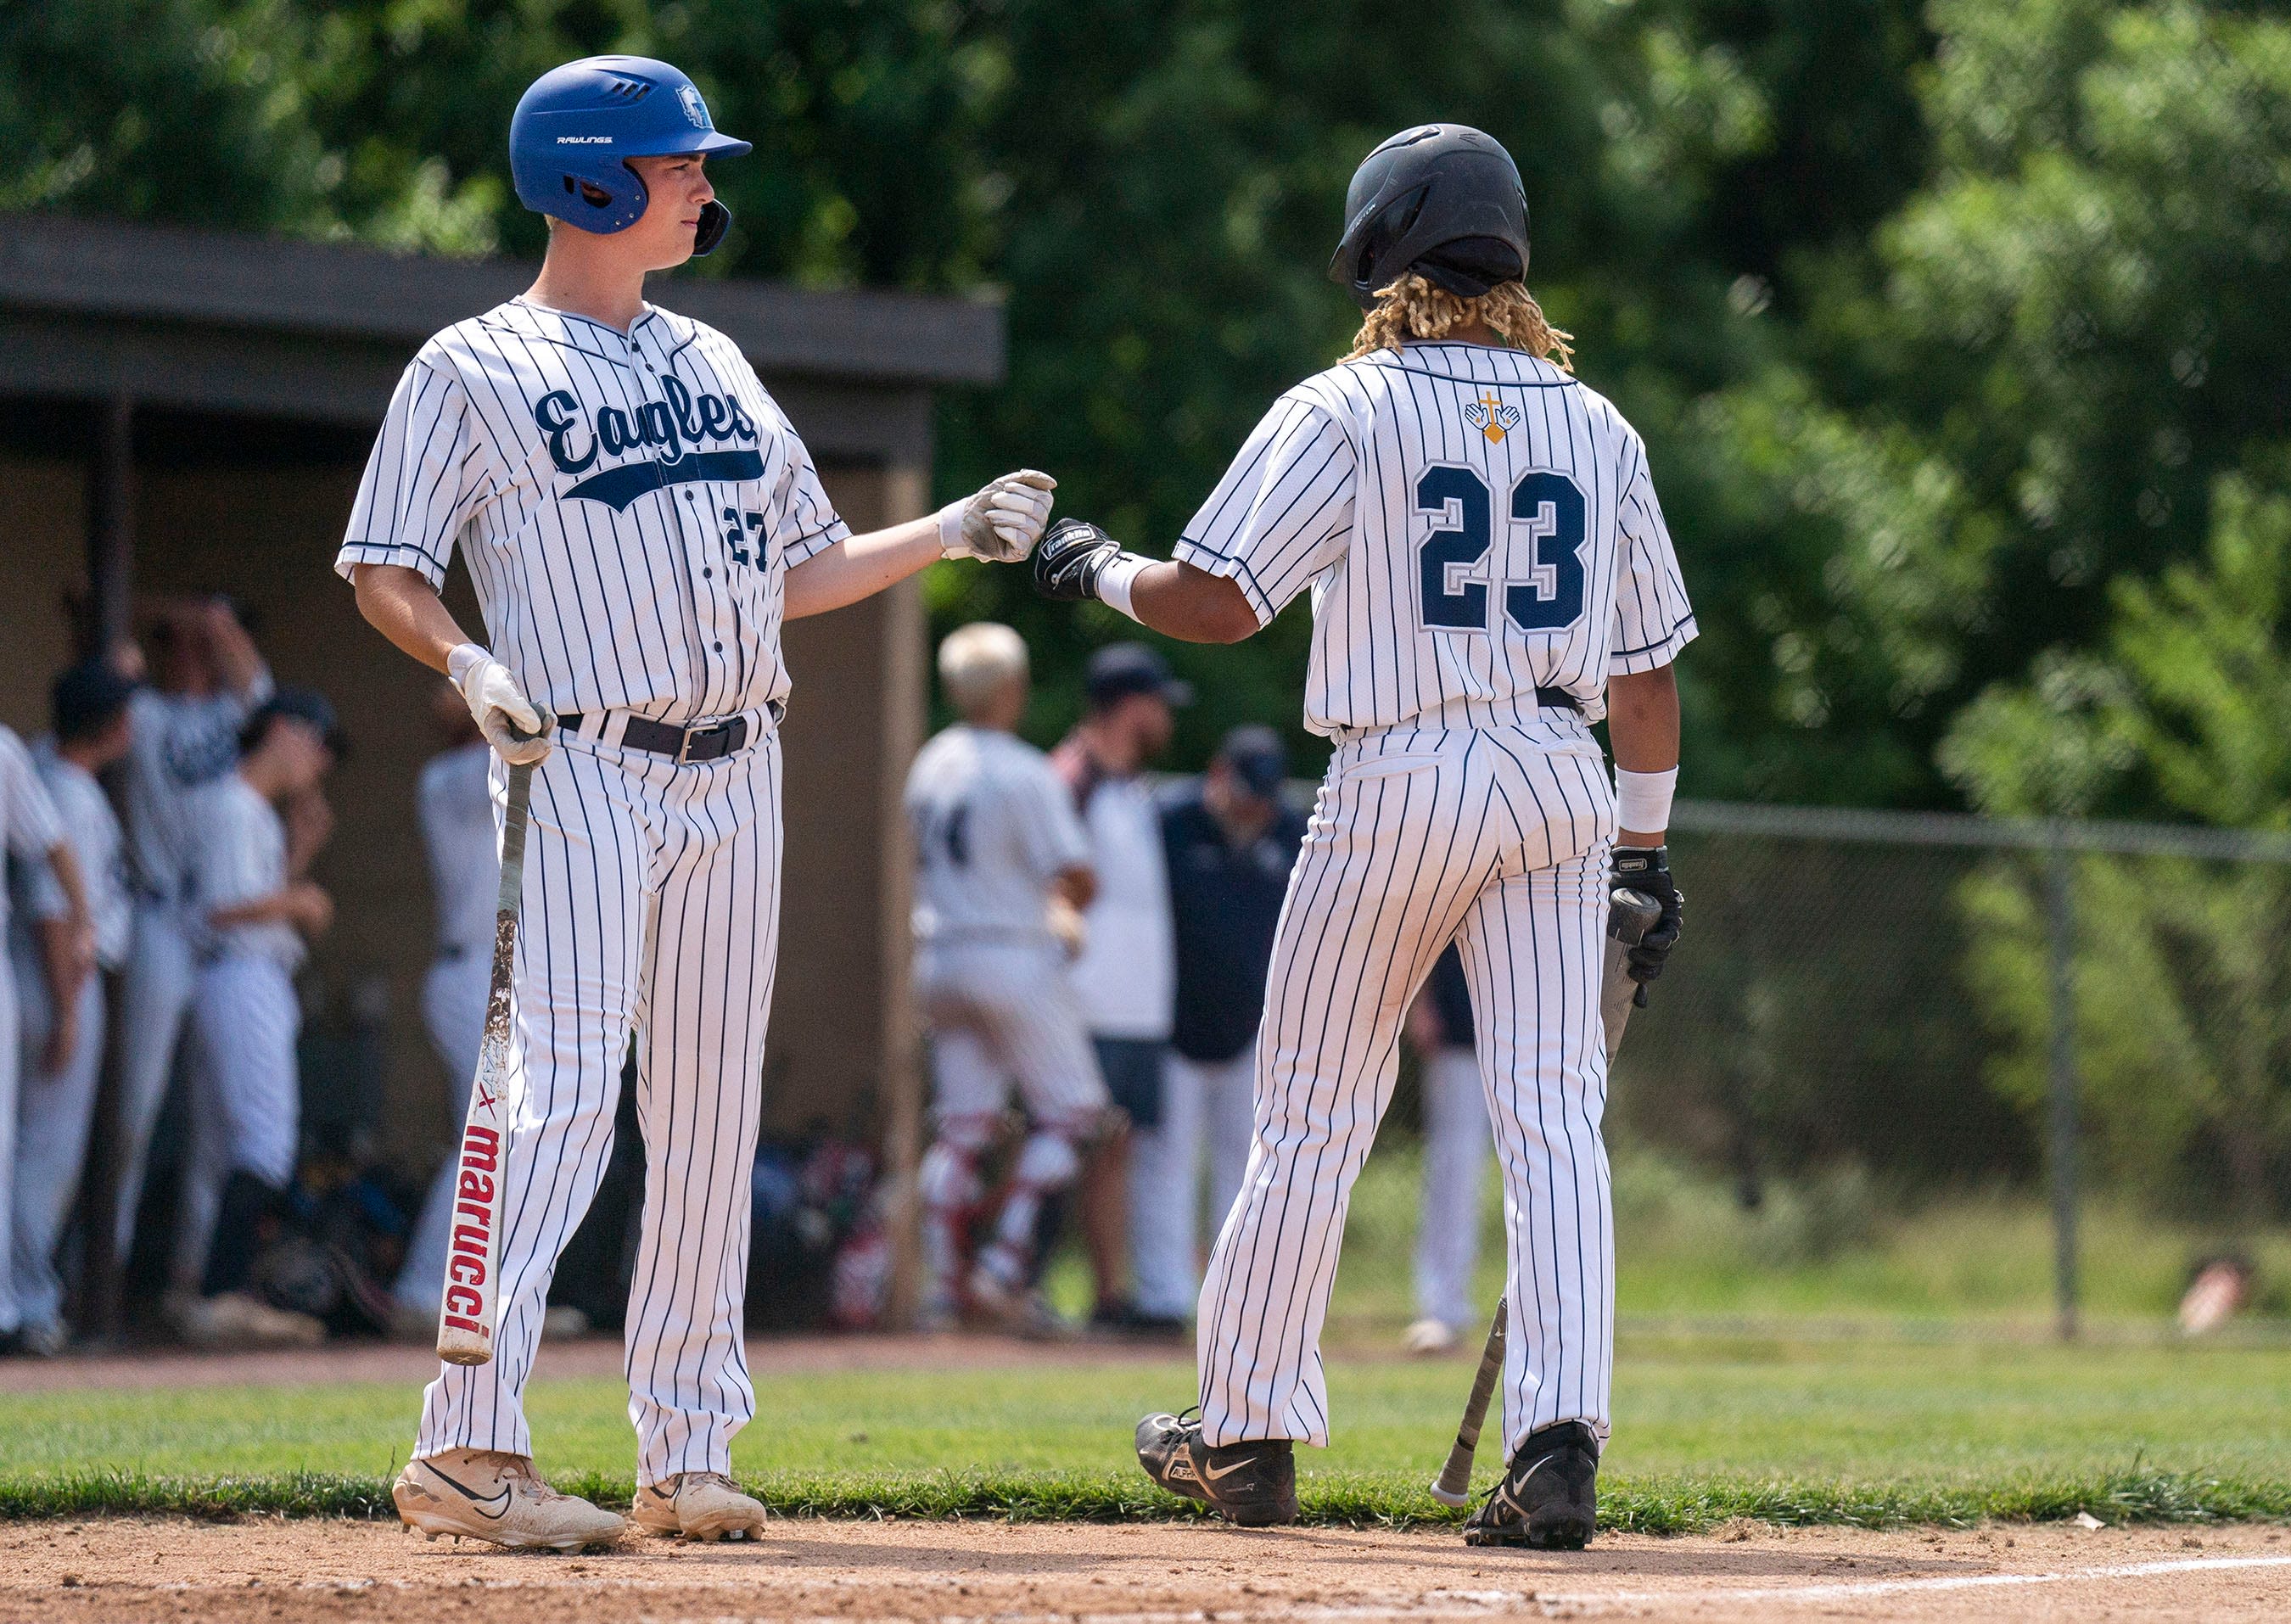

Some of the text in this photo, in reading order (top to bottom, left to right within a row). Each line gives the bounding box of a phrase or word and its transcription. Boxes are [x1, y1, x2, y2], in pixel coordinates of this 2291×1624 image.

[534, 373, 758, 475] Eagles
[722, 505, 769, 574] 27
[1413, 459, 1589, 635] 23
[445, 1125, 500, 1339] marucci
